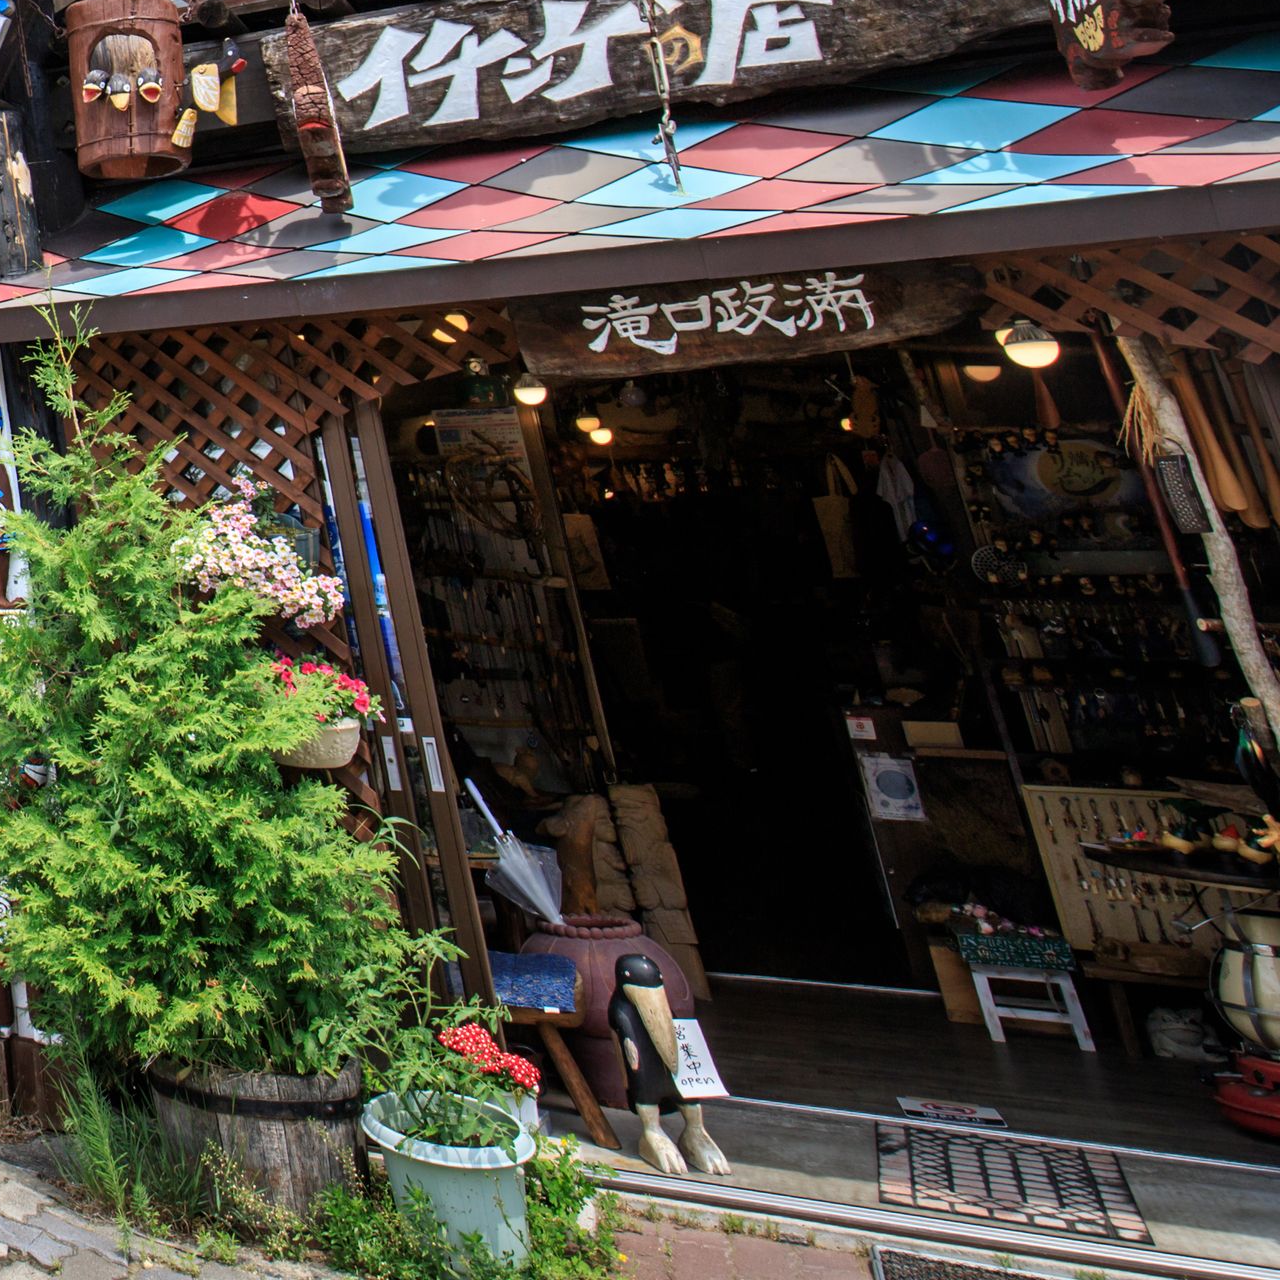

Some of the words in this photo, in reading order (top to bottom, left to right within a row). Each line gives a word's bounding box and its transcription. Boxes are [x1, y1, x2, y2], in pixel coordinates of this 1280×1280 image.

[580, 272, 874, 355] 滝口政満
[681, 1076, 715, 1088] open
